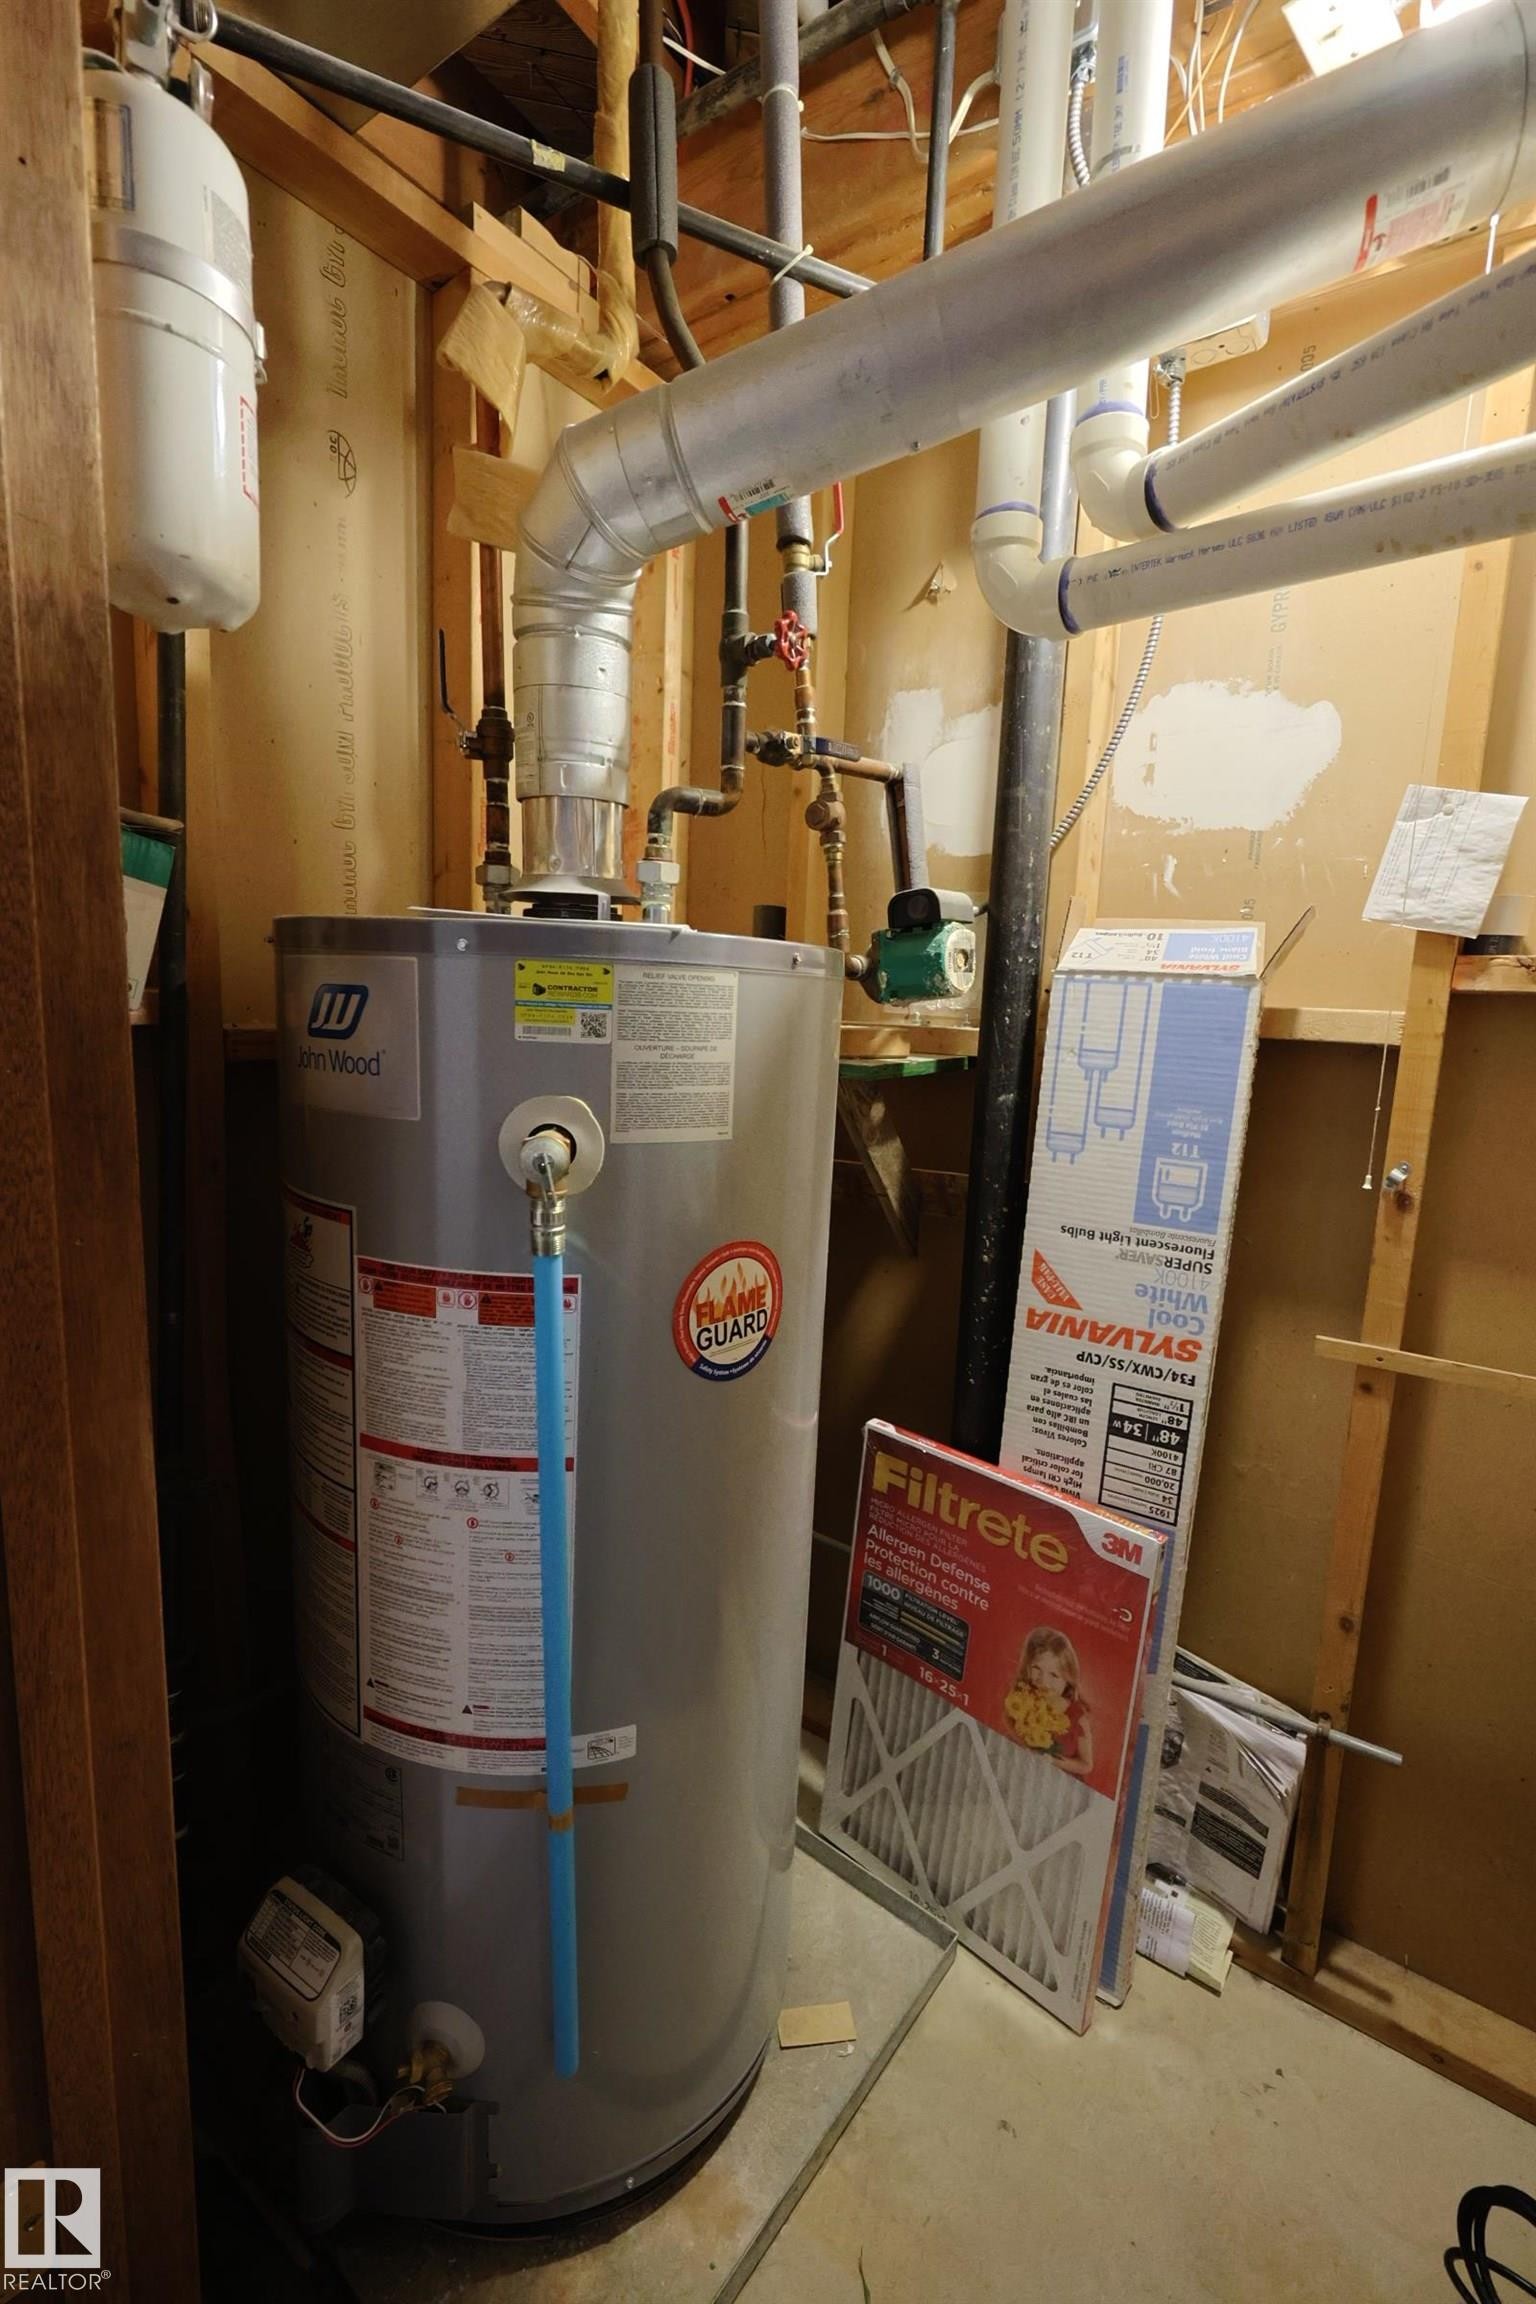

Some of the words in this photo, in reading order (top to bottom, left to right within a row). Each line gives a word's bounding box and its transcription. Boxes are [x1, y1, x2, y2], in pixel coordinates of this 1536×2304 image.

[1271, 588, 1290, 636] GYPR
[1147, 932, 1164, 941] 10
[1071, 951, 1093, 959] T12
[1160, 963, 1240, 971] SYLVANIA
[298, 1046, 326, 1071] John
[329, 1049, 380, 1076] Wood
[1171, 1142, 1200, 1158] T12
[1060, 1225, 1096, 1240] Bulbs
[1099, 1231, 1132, 1249] Light
[1135, 1237, 1215, 1260] Fluorescent
[1153, 1268, 1211, 1292] 4100K
[696, 1284, 767, 1328] FLAME
[1134, 1283, 1209, 1315] White
[1148, 1308, 1206, 1336] Cool
[696, 1309, 768, 1351] GUARD
[1025, 1307, 1203, 1363] SYLVANIA
[1044, 1367, 1095, 1385] importancia.
[1075, 1351, 1196, 1387] F34/CWX/SS/CVP
[1030, 1373, 1048, 1384] gran
[1050, 1379, 1060, 1389] de
[1043, 1388, 1051, 1396] el
[1053, 1391, 1079, 1403] cuales
[1072, 1384, 1094, 1395] color
[1041, 1396, 1091, 1416] aplicaciones
[1080, 1397, 1093, 1406] las
[1026, 1404, 1045, 1415] para
[1046, 1409, 1062, 1421] alto
[1032, 1417, 1047, 1425] con
[1078, 1418, 1090, 1426] un
[1031, 1426, 1056, 1440] Vivos:
[1048, 1420, 1089, 1438] Bombillas
[1057, 1433, 1088, 1448] Colores
[1152, 1429, 1182, 1447] 48"
[1021, 1455, 1049, 1469] critical
[1034, 1449, 1085, 1467] applications.
[1151, 1448, 1179, 1463] 4100K
[1023, 1466, 1047, 1480] lamps
[1049, 1463, 1073, 1475] color
[1074, 1469, 1083, 1479] for
[1148, 1462, 1164, 1473] CRI
[1165, 1467, 1177, 1476] 87
[1048, 1474, 1061, 1484] CRI
[1063, 1477, 1082, 1489] High
[1144, 1475, 1175, 1491] 20,000
[1161, 1494, 1173, 1505] 34
[871, 1450, 1069, 1574] Filtrete
[1148, 1505, 1172, 1520] 1925
[871, 1498, 895, 1513] MICRO
[897, 1509, 938, 1533] ALLERGEN
[940, 1528, 968, 1548] FILTER
[897, 1516, 921, 1533] MICRO
[1101, 1532, 1144, 1566] 3M
[867, 1524, 926, 1561] Allergen
[930, 1556, 991, 1595] Defense
[863, 1553, 884, 1572] les
[885, 1566, 959, 1611] allergènes
[865, 1540, 937, 1586] Protection
[941, 1579, 990, 1612] contre
[867, 1574, 900, 1601] 1000
[932, 1648, 939, 1659] 3
